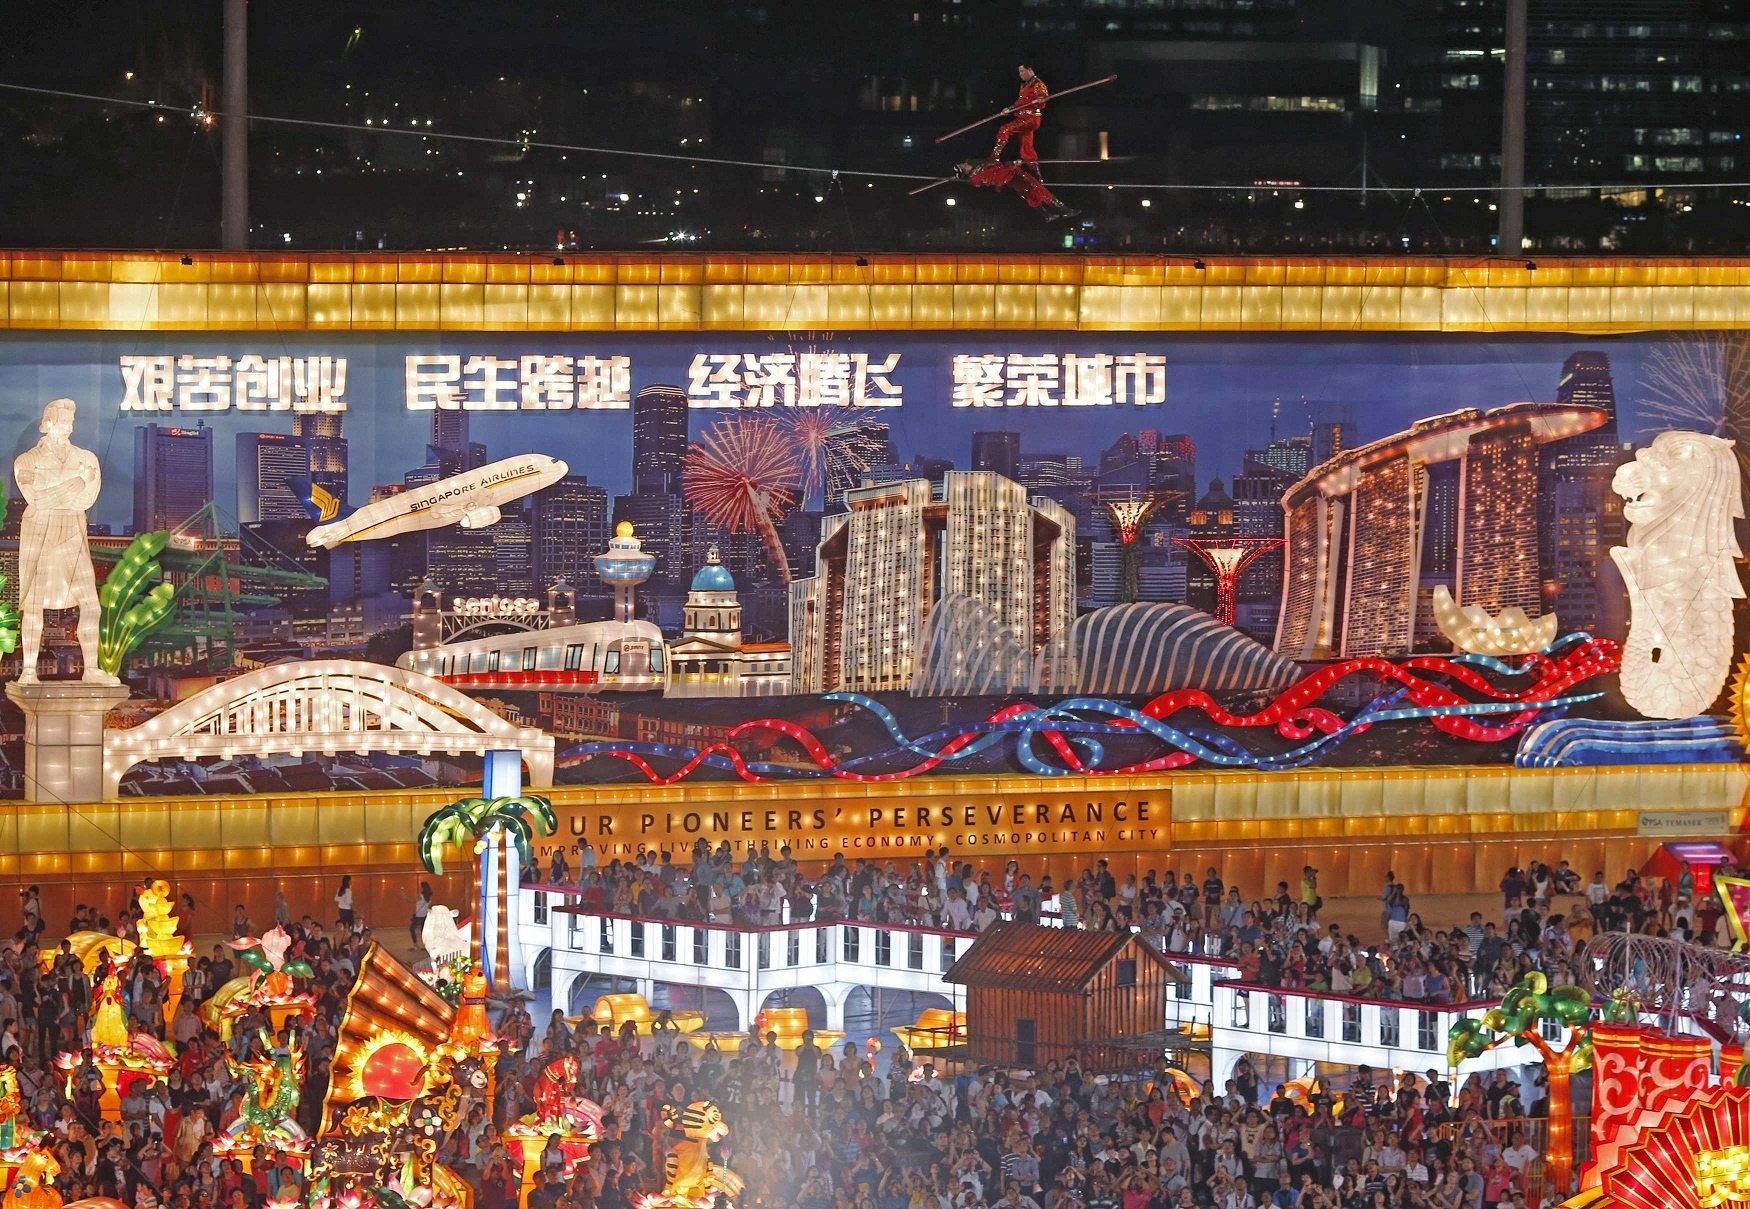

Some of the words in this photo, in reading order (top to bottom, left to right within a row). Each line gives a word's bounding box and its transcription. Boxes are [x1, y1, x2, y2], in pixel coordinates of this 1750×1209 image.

[120, 354, 348, 411] 艰苦创业
[405, 354, 631, 411] 民生跨越
[688, 353, 903, 409] 经济腾飞
[952, 352, 1167, 408] 繁荣城市
[410, 483, 476, 512] SINGAPORE
[480, 464, 535, 487] AIRLINES
[870, 801, 1149, 828] PERSEVERANCE
[1665, 819, 1702, 827] TEMASEK
[531, 842, 646, 858] IMPRVING
[842, 835, 943, 848] ECONOMY,
[955, 830, 1105, 846] COSMOPOLITAN
[1118, 829, 1158, 841] CITY
